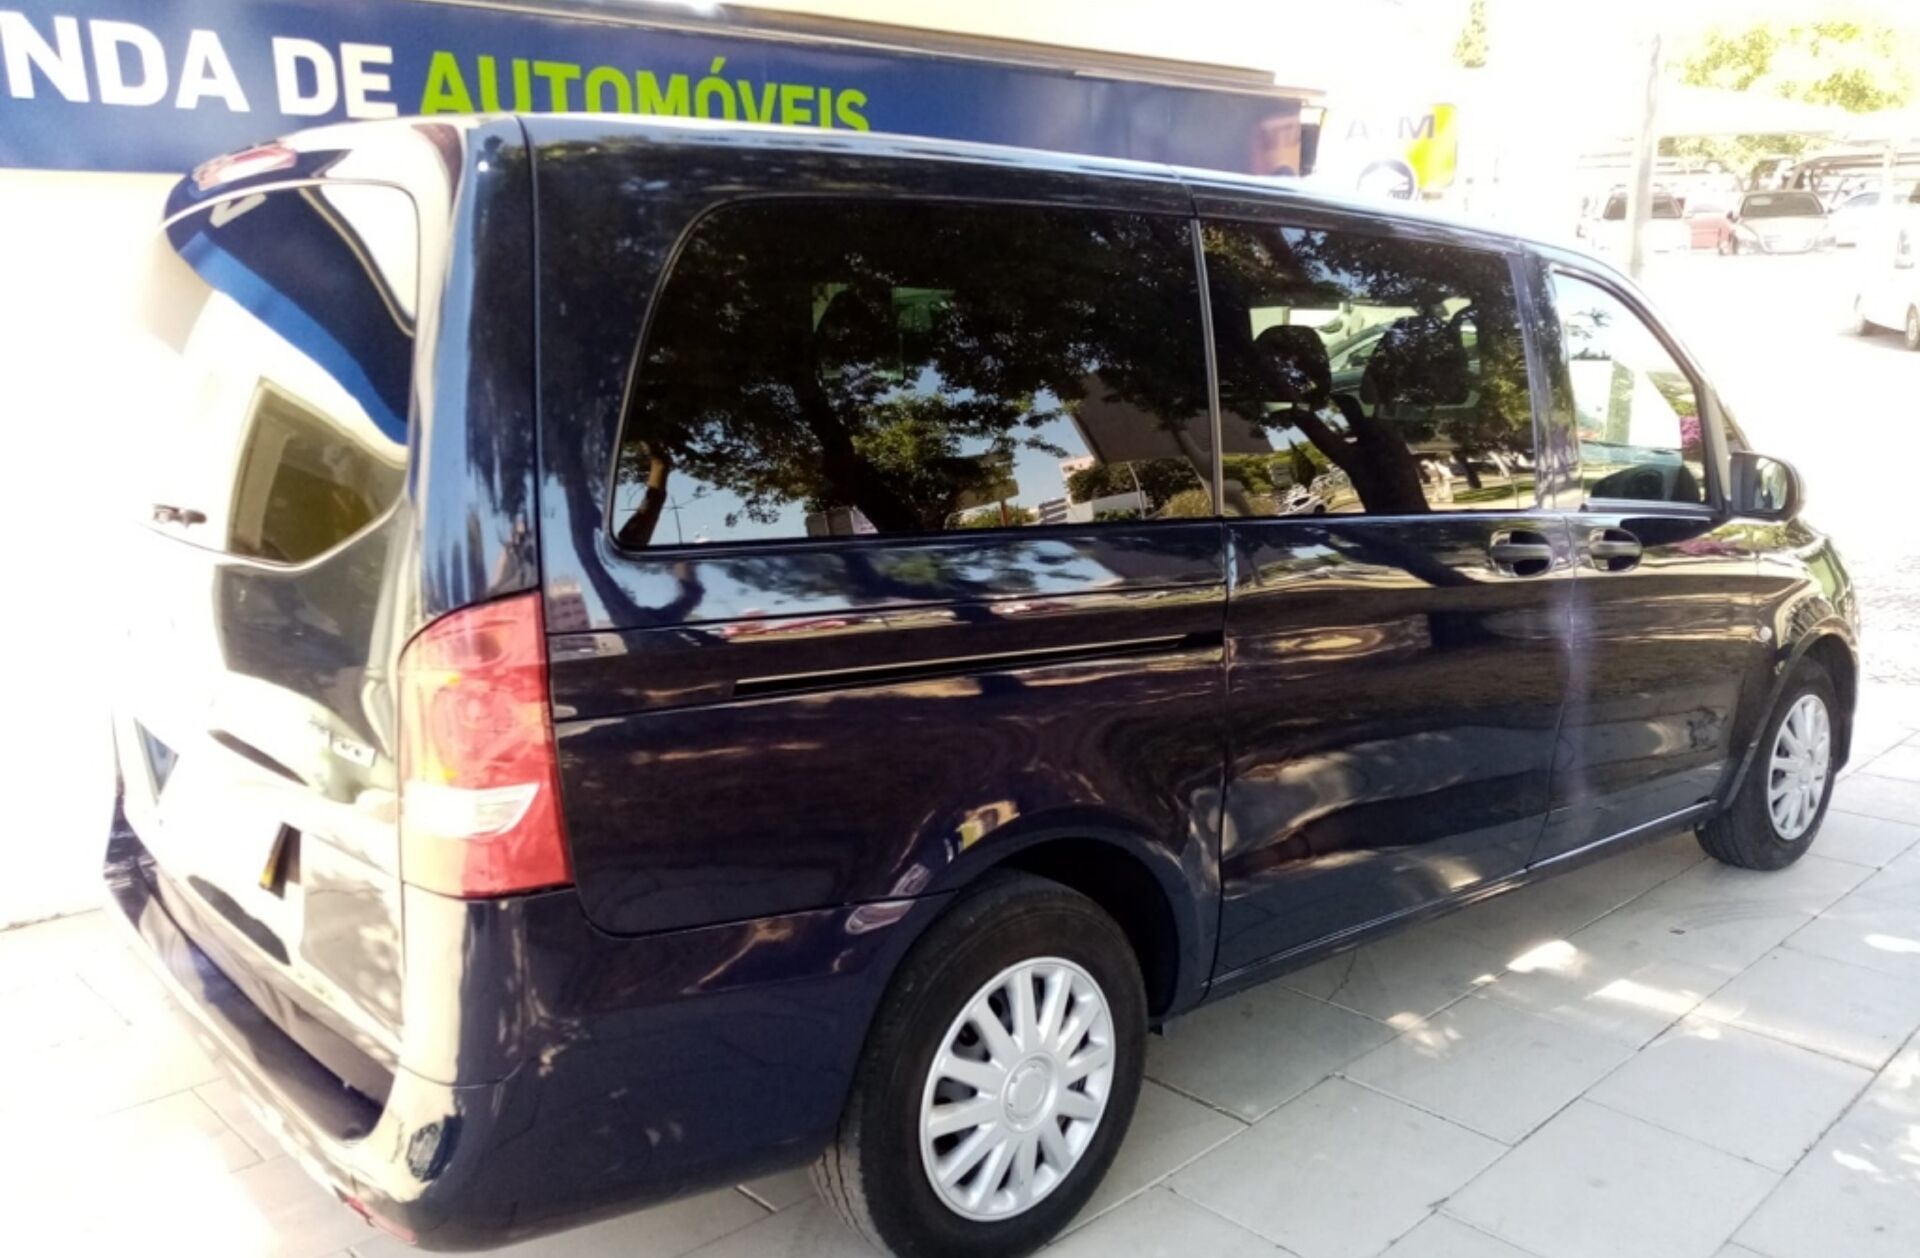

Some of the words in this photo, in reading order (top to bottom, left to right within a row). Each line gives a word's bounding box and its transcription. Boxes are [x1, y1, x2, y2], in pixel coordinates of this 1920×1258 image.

[0, 10, 250, 112] NDA
[271, 36, 398, 119] DE
[419, 50, 870, 132] AUTOMÓVEIS
